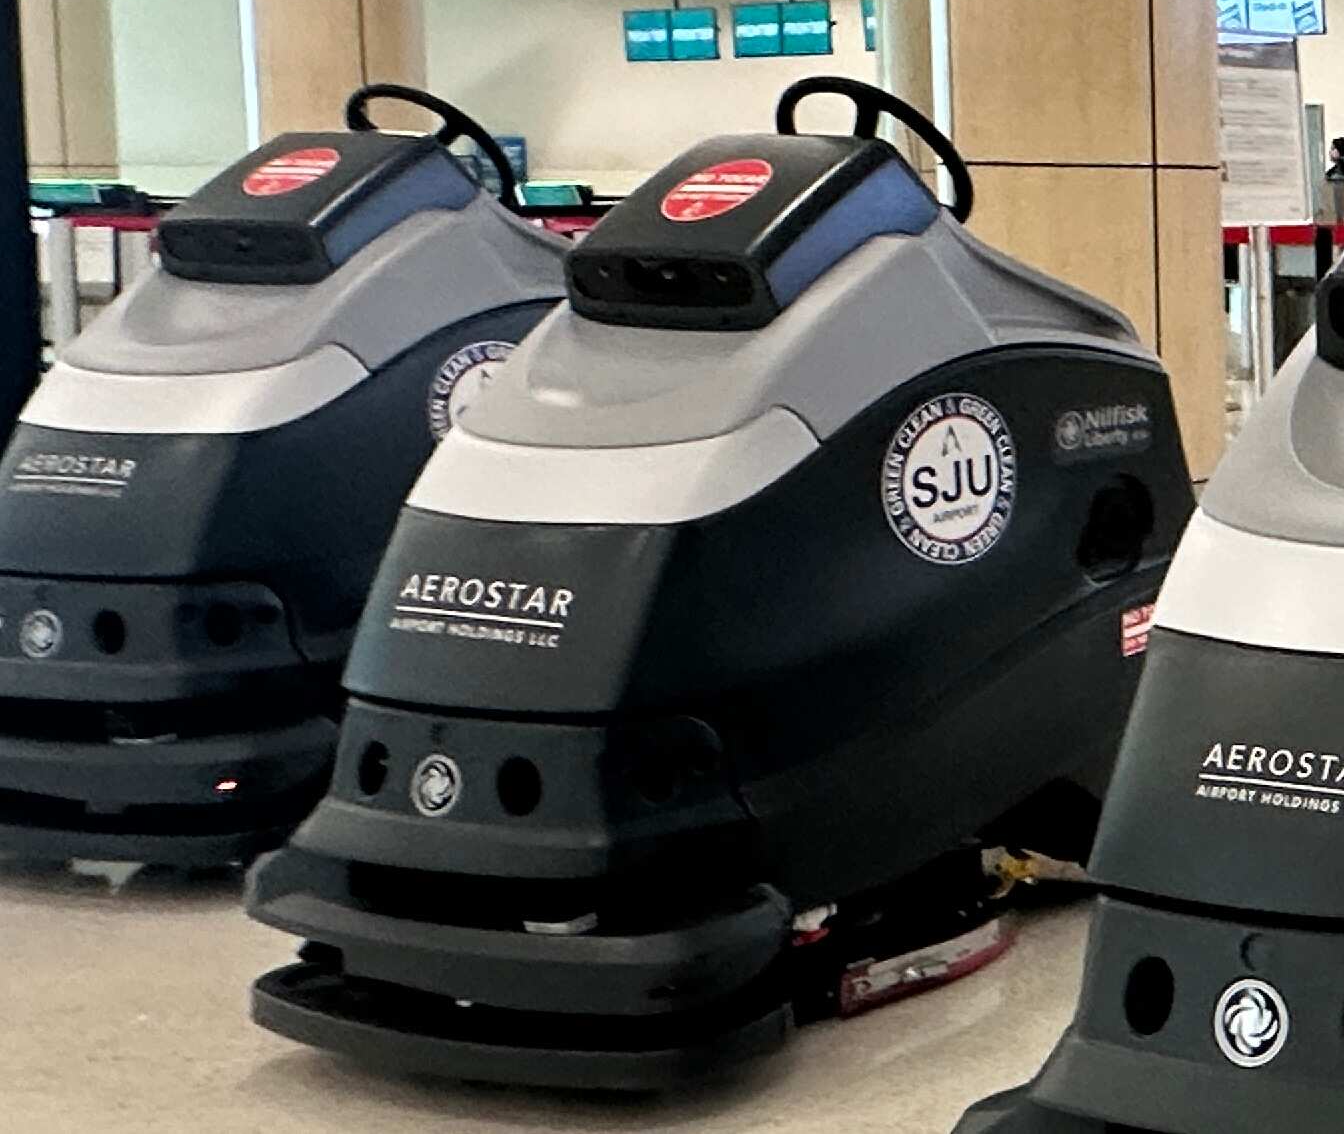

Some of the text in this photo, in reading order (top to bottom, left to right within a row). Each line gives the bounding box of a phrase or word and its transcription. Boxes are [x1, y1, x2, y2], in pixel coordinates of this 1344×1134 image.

[911, 454, 992, 508] SJU
[400, 573, 574, 616] AEROSTAR
[1195, 783, 1257, 802] AIRPORT
[1259, 792, 1341, 814] HOLDINGS
